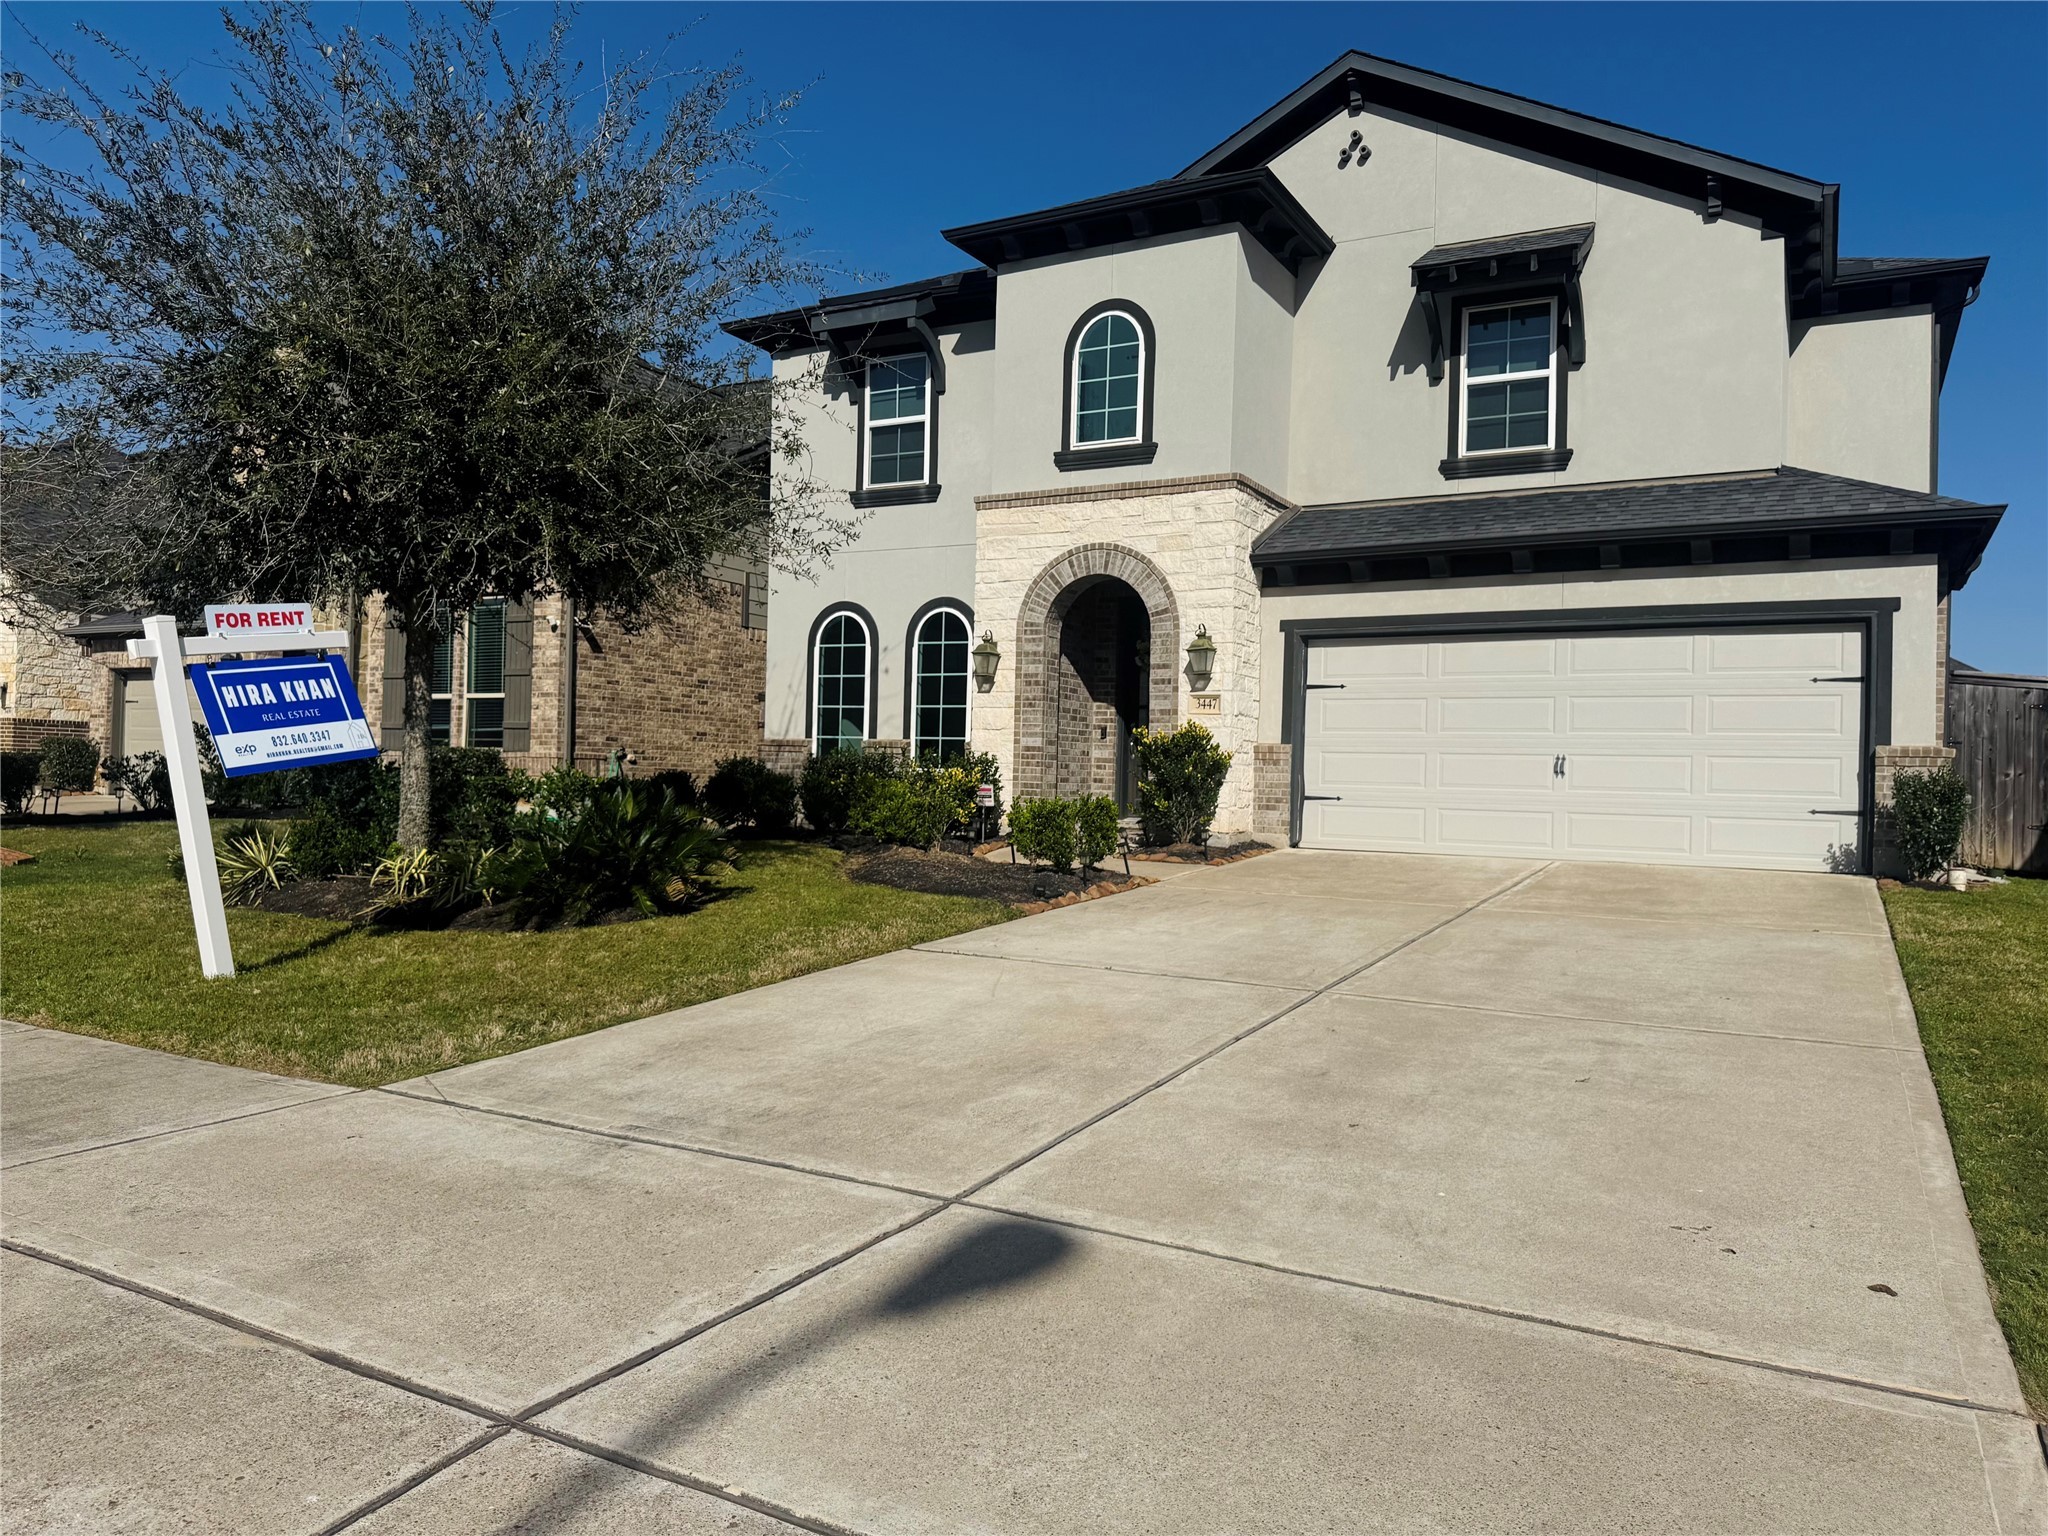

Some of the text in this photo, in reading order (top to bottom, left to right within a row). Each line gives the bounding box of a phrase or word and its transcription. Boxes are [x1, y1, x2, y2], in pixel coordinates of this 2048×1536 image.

[214, 611, 305, 628] FOR RENT
[221, 678, 336, 708] HIRA KHAN
[1195, 697, 1217, 710] 3447
[262, 708, 321, 722] REAL ESTATE
[271, 729, 331, 747] 832.640.3347
